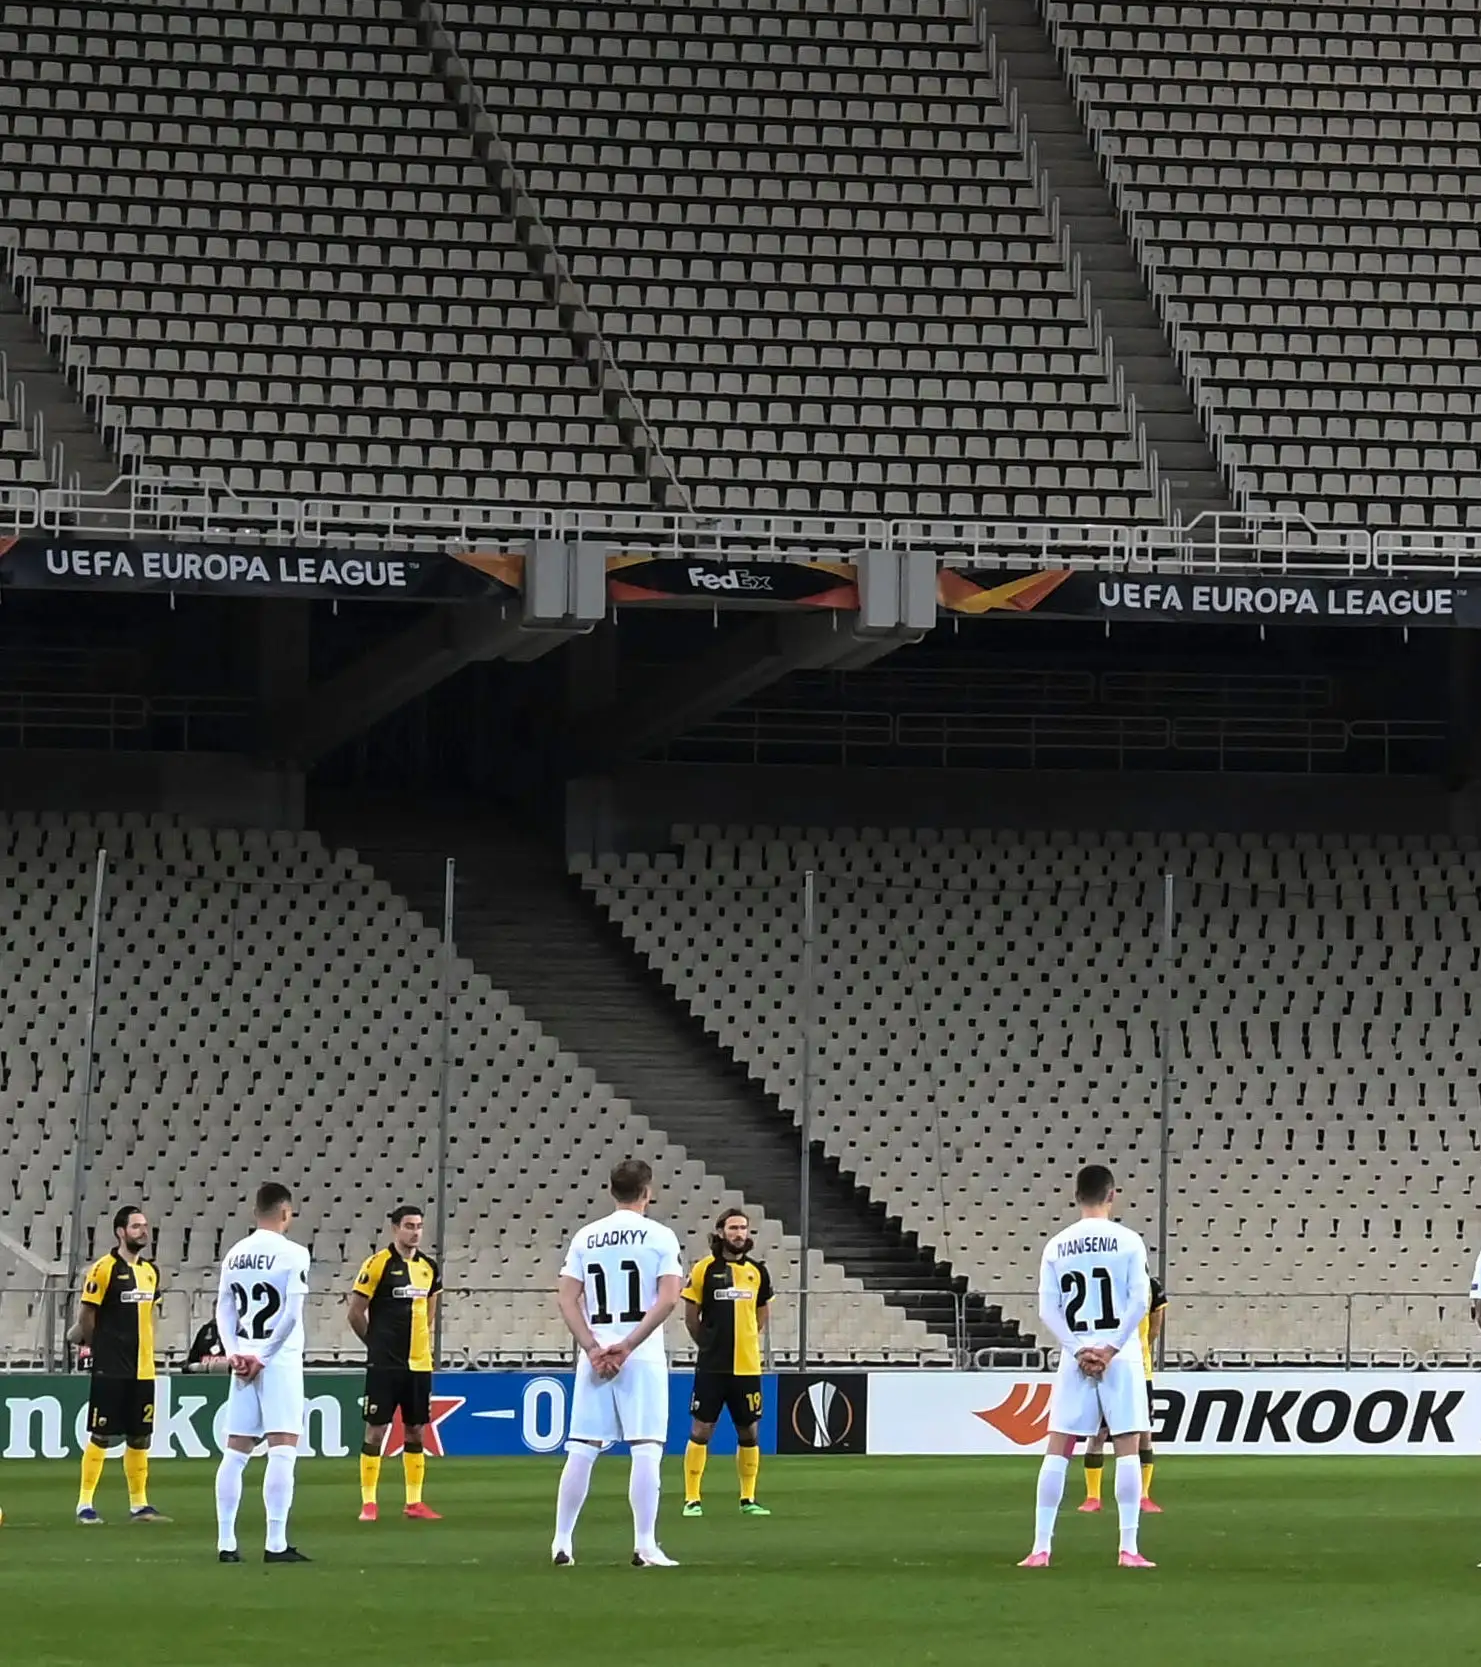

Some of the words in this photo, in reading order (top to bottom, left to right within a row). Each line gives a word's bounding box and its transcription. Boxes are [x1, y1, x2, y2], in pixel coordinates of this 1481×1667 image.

[45, 549, 134, 578] UEFA
[141, 552, 271, 582] EUROPA
[279, 557, 407, 587] LEAGUE
[687, 567, 773, 590] FedEx
[1099, 581, 1184, 611] UEFA
[1191, 585, 1319, 614] EUROPA
[1327, 588, 1453, 615] LEAGUE
[587, 1260, 647, 1325] 11
[1060, 1267, 1121, 1332] 21
[745, 1391, 762, 1412] 19
